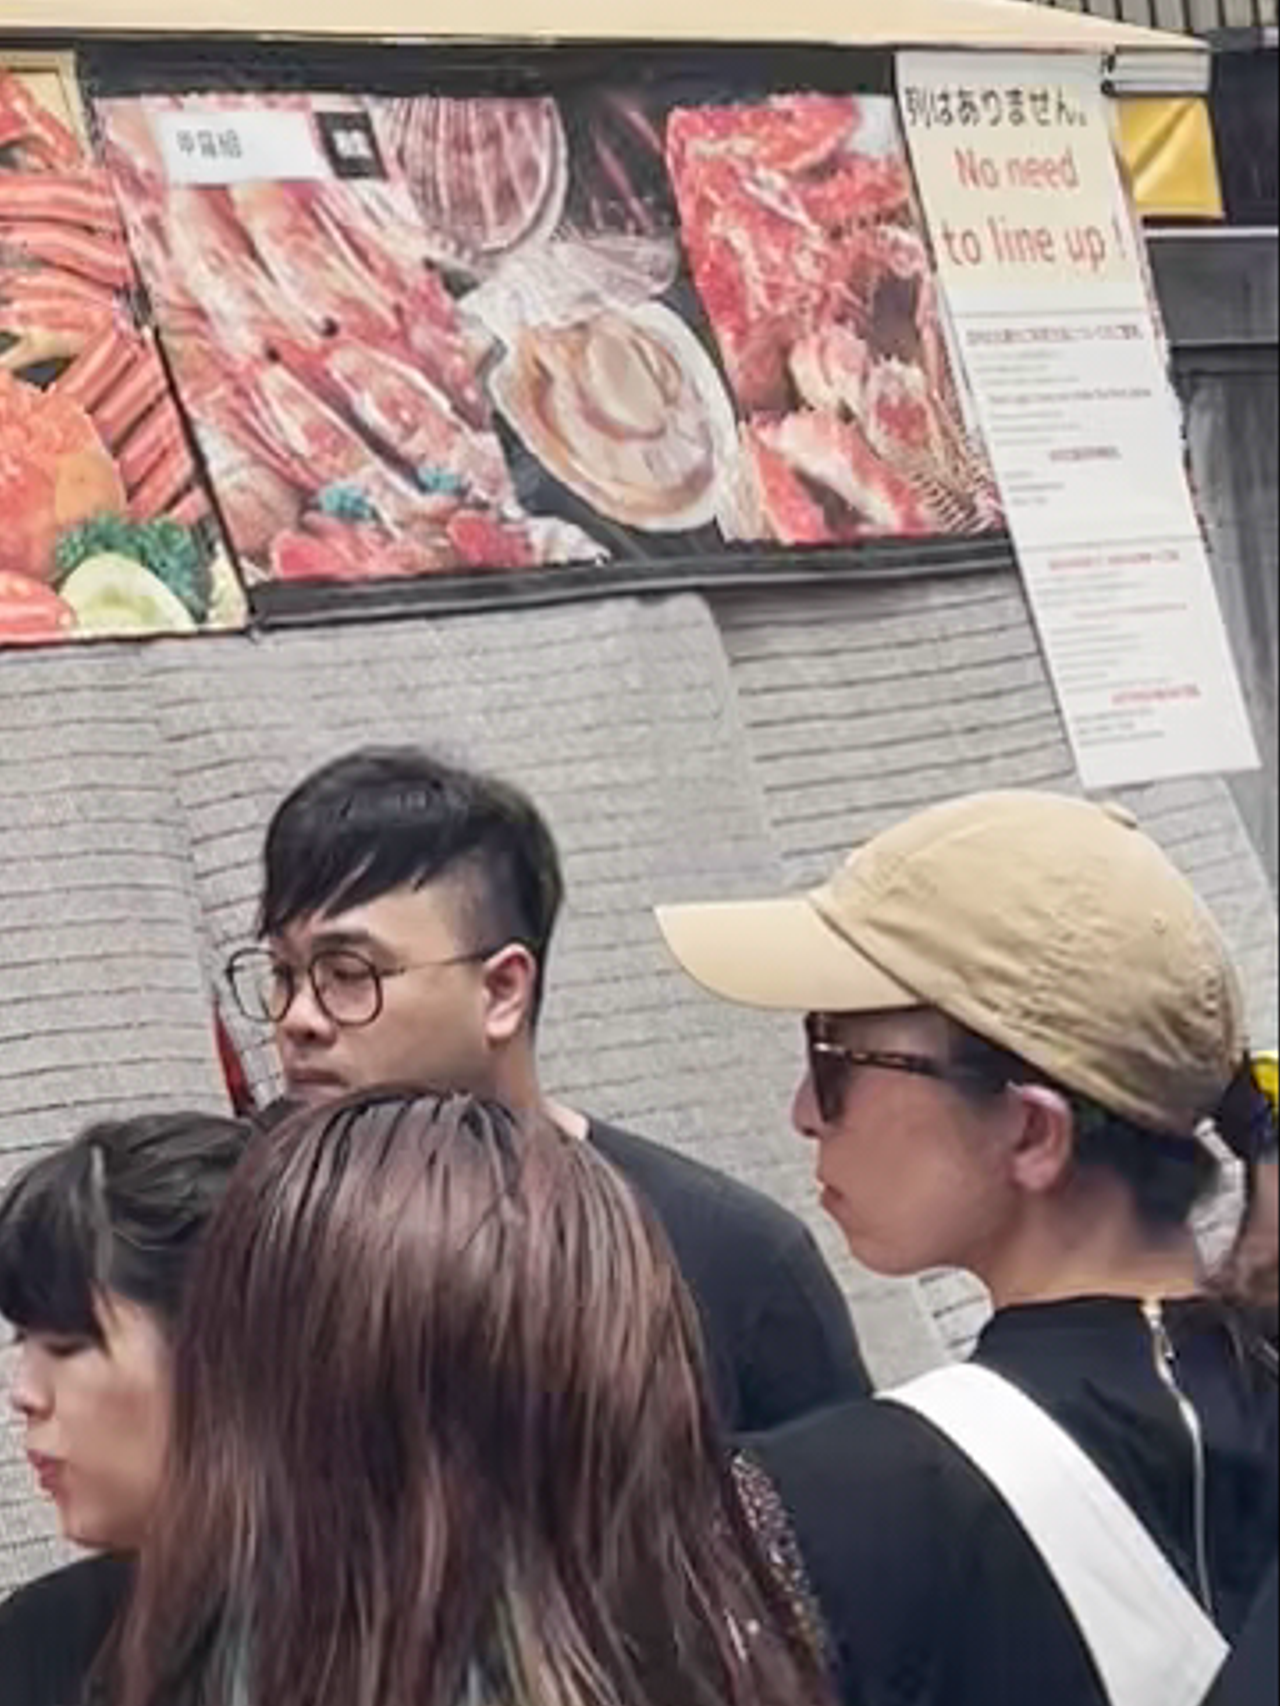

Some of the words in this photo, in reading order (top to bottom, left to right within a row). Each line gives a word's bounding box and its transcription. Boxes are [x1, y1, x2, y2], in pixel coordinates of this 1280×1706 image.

[955, 146, 998, 189] No
[1008, 145, 1080, 188] need
[942, 218, 982, 266] to
[987, 215, 1056, 264] line
